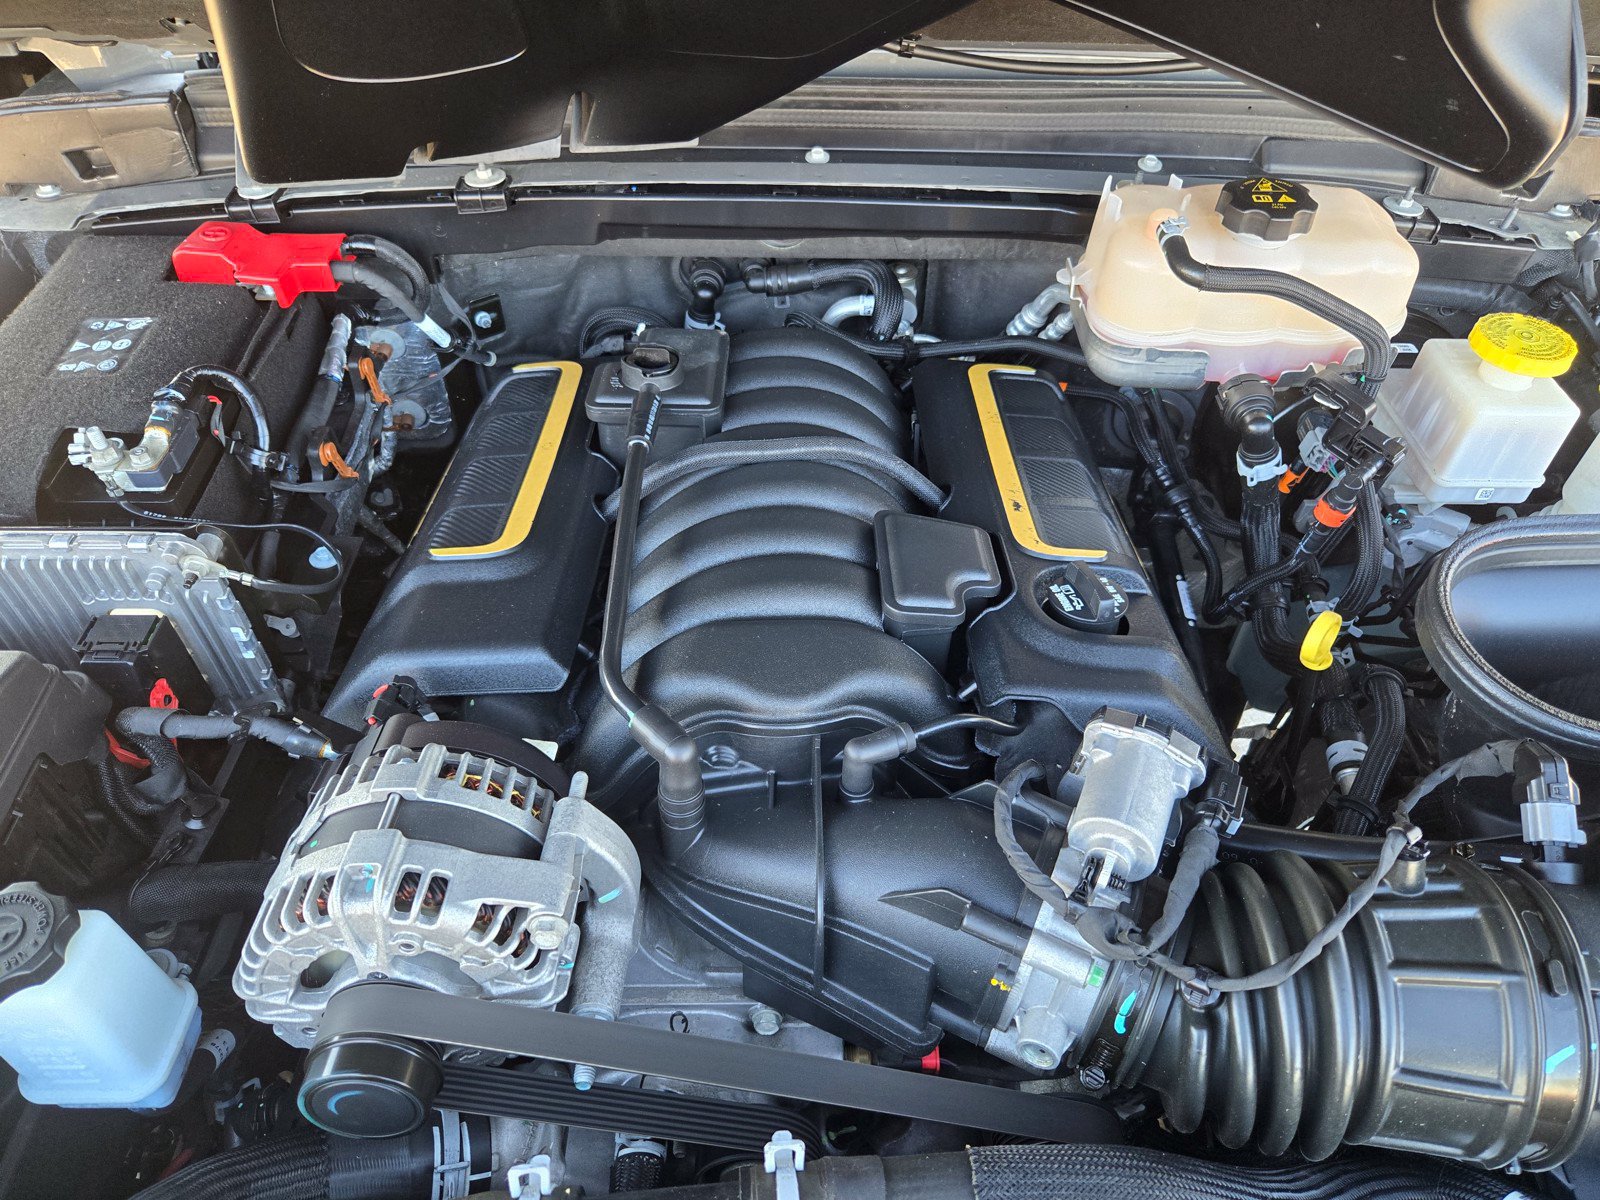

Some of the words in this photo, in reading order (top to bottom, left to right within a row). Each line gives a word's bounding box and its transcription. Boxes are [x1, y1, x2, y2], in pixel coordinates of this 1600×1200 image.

[1049, 583, 1061, 593] OIL
[1055, 591, 1074, 612] ENGINE
[32, 900, 48, 935] POWER
